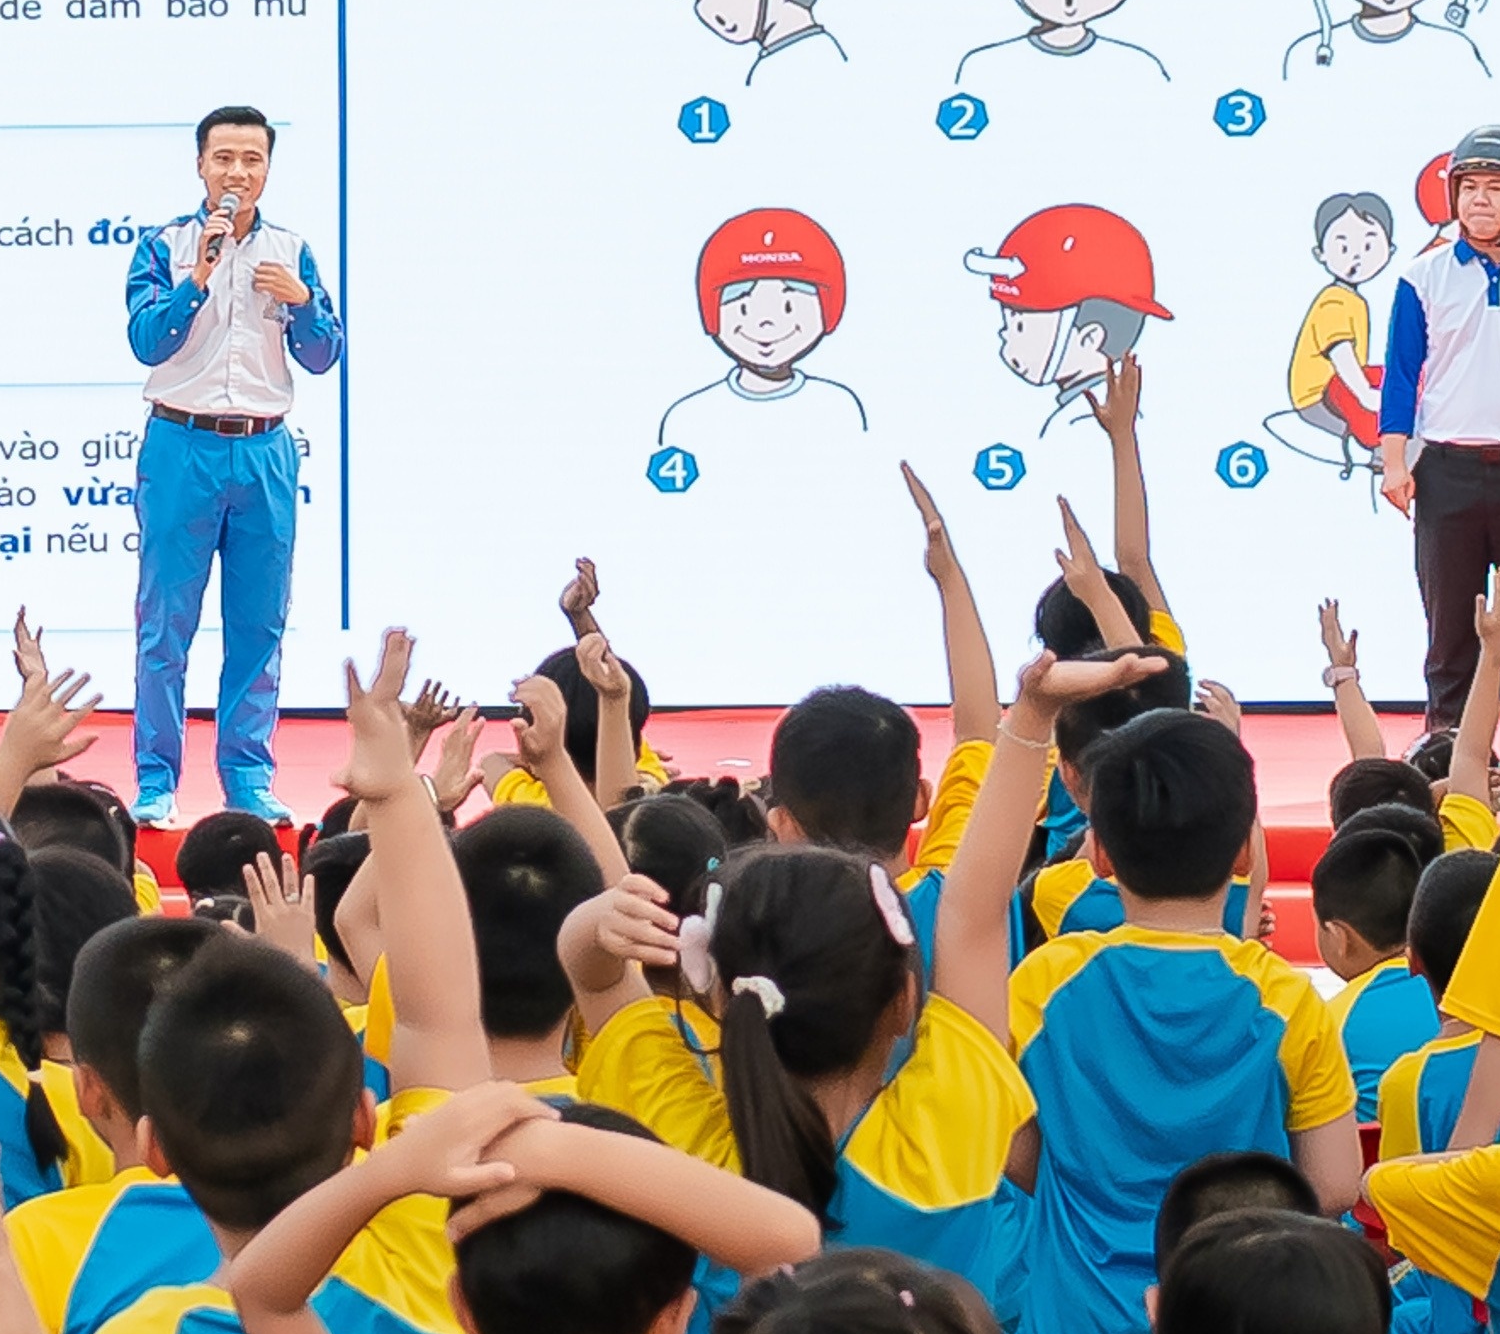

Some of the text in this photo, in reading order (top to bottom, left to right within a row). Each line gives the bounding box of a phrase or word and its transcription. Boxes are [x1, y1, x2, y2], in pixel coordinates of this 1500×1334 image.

[694, 102, 717, 139] 1
[950, 99, 977, 136] 2
[1228, 96, 1254, 132] 3
[740, 251, 803, 264] HONDA
[81, 430, 142, 468] giữ
[987, 449, 1014, 486] 5
[1229, 447, 1257, 485] 6
[658, 452, 688, 489] 4
[62, 476, 136, 506] vừa
